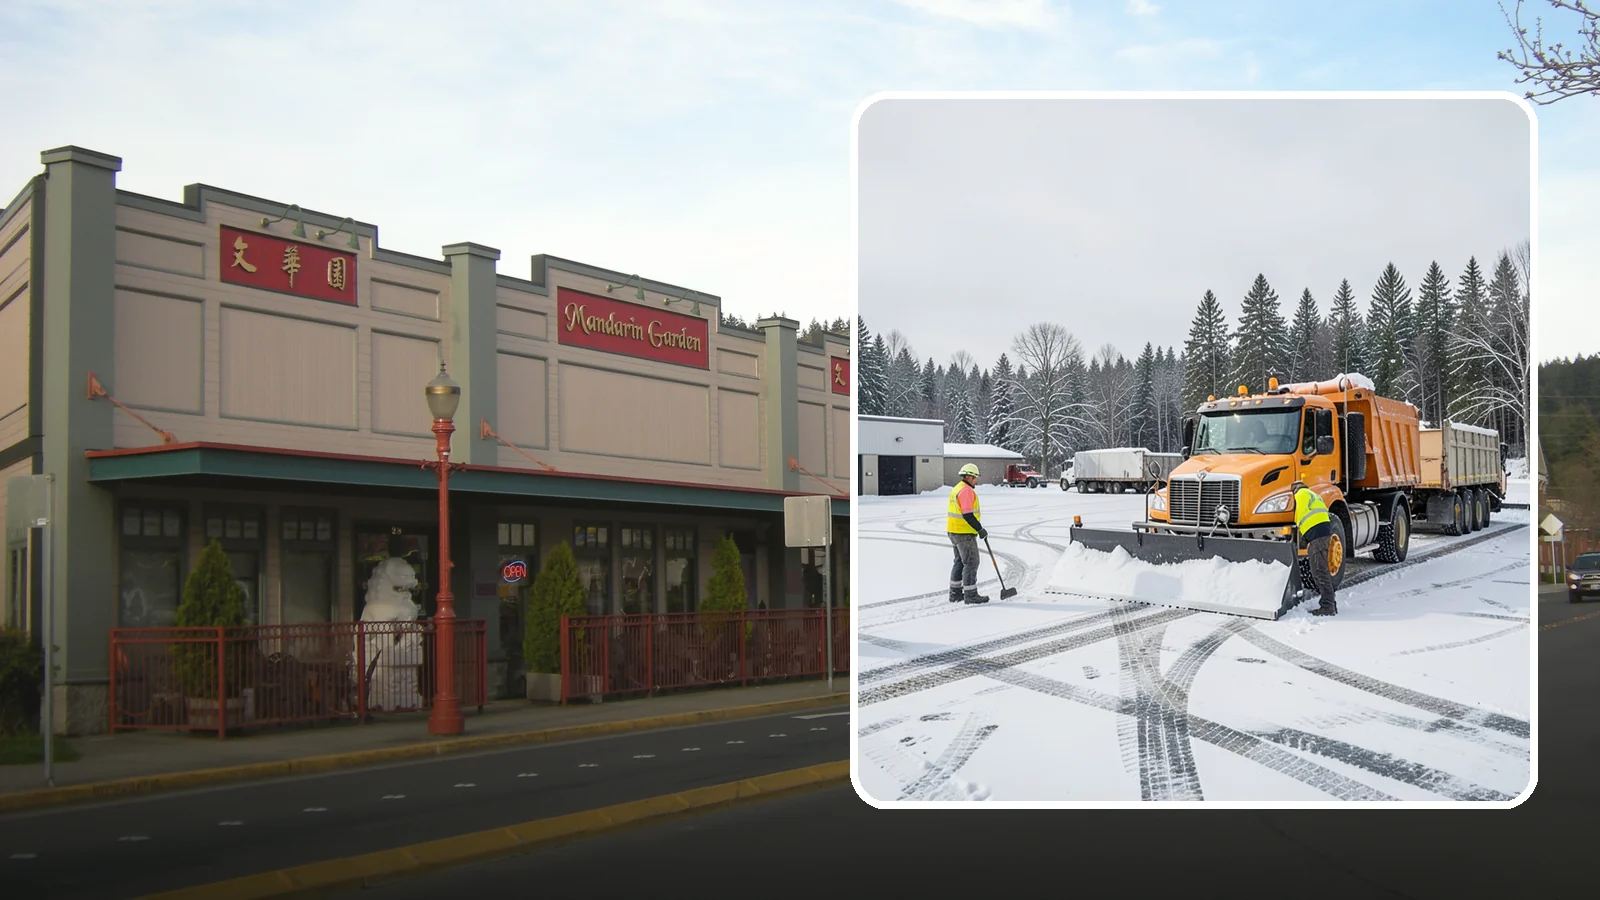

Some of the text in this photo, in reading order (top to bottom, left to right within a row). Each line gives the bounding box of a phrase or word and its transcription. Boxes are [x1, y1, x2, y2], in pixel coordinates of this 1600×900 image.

[230, 235, 347, 291] 文華園
[564, 302, 701, 352] Mandarin Garden
[503, 565, 527, 578] OPEN
